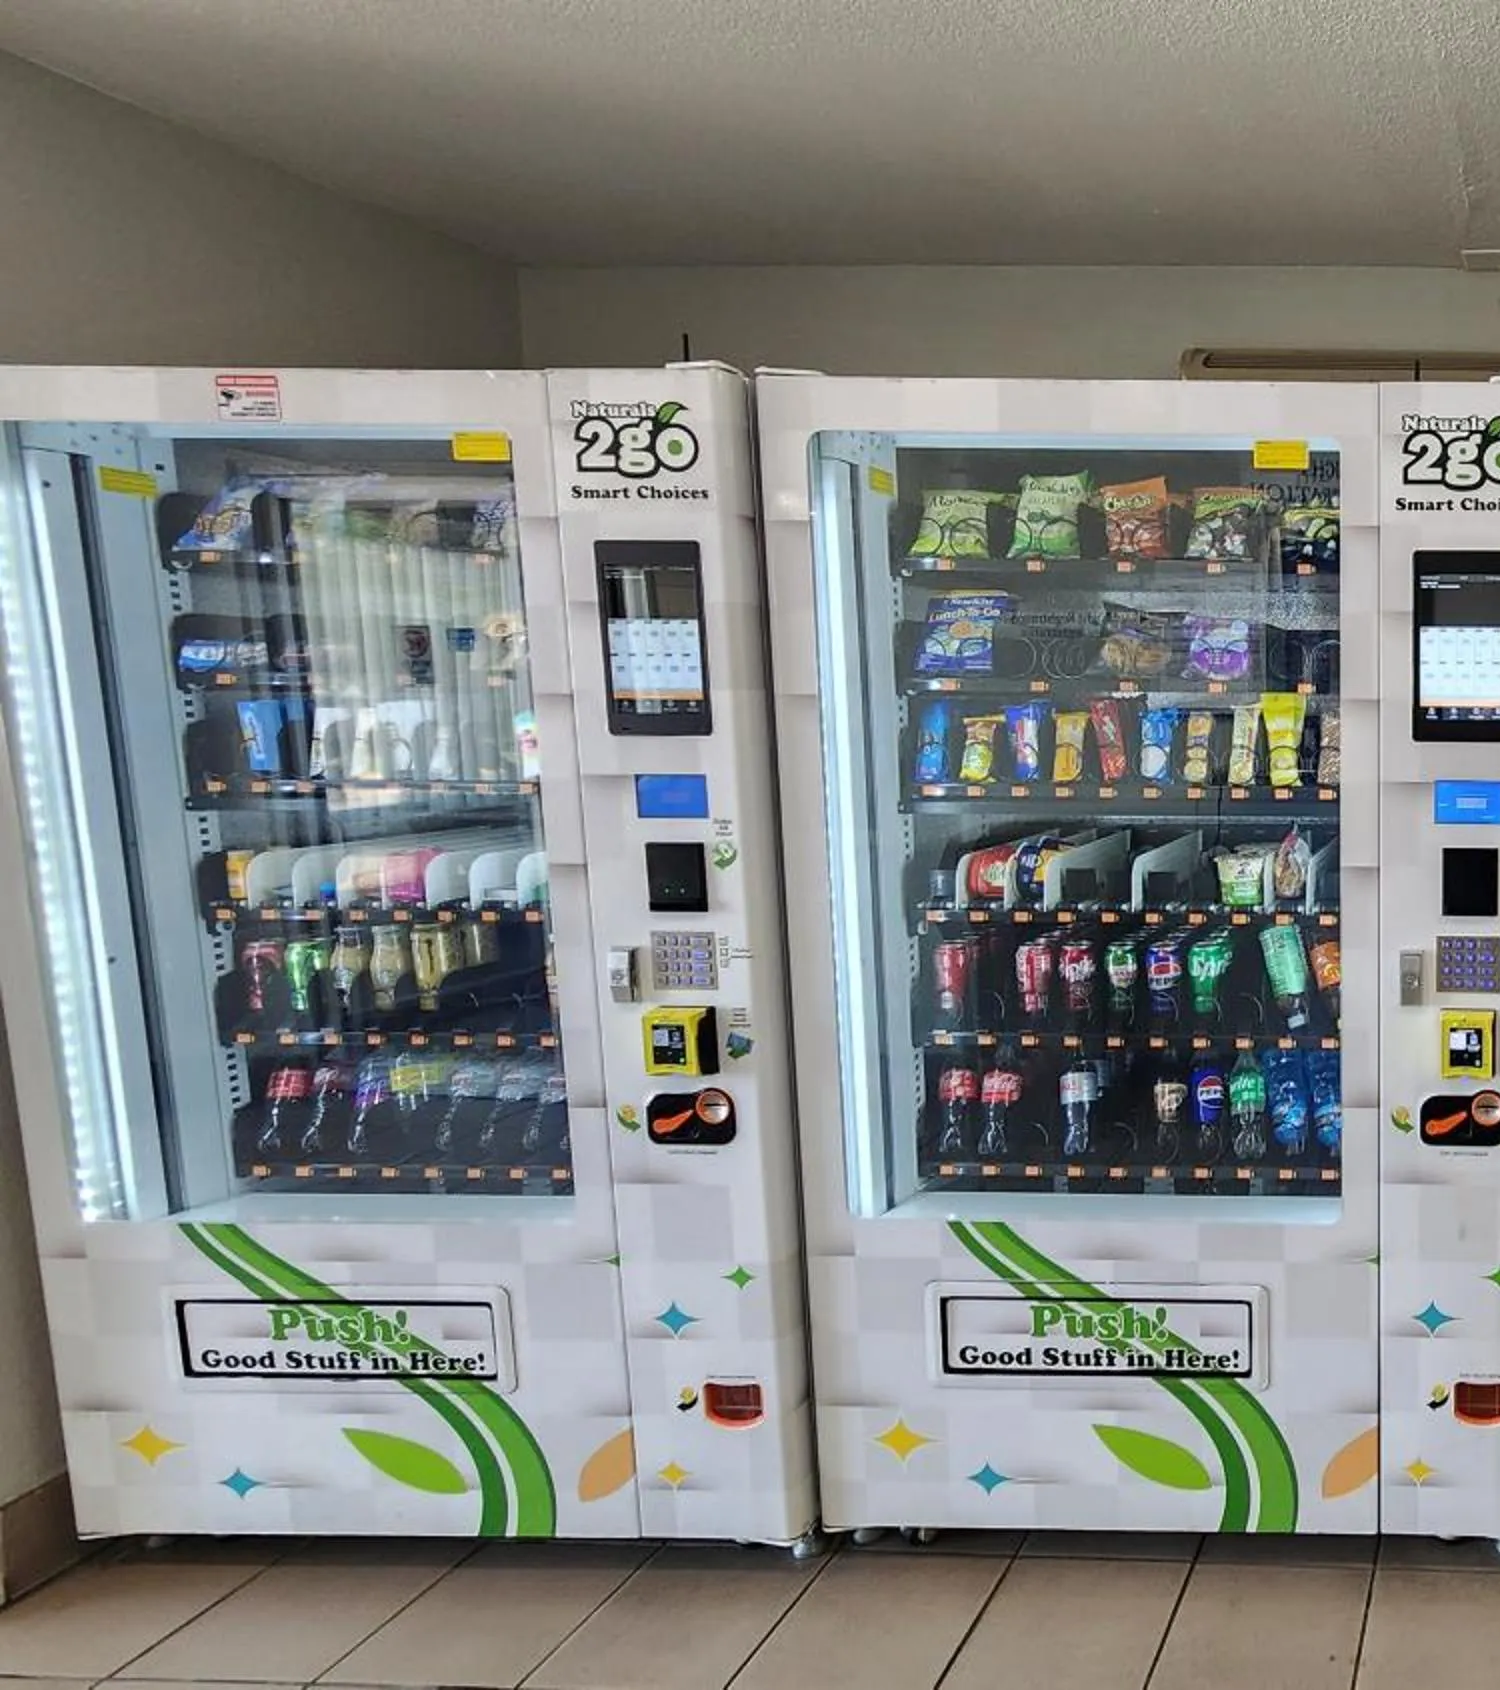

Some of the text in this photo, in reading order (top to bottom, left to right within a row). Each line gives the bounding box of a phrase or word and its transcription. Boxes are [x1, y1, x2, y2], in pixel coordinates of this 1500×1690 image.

[570, 401, 657, 418] Naturals
[1401, 414, 1488, 432] Naturals
[574, 415, 699, 479] 2go
[571, 485, 709, 499] Smart Choices
[1395, 498, 1454, 511] Smart
[267, 1308, 411, 1344] Push!
[1030, 1304, 1169, 1341] Push!
[200, 1350, 486, 1372] Good Stuff in Here!
[959, 1346, 1240, 1370] Good Stuff in Here!
